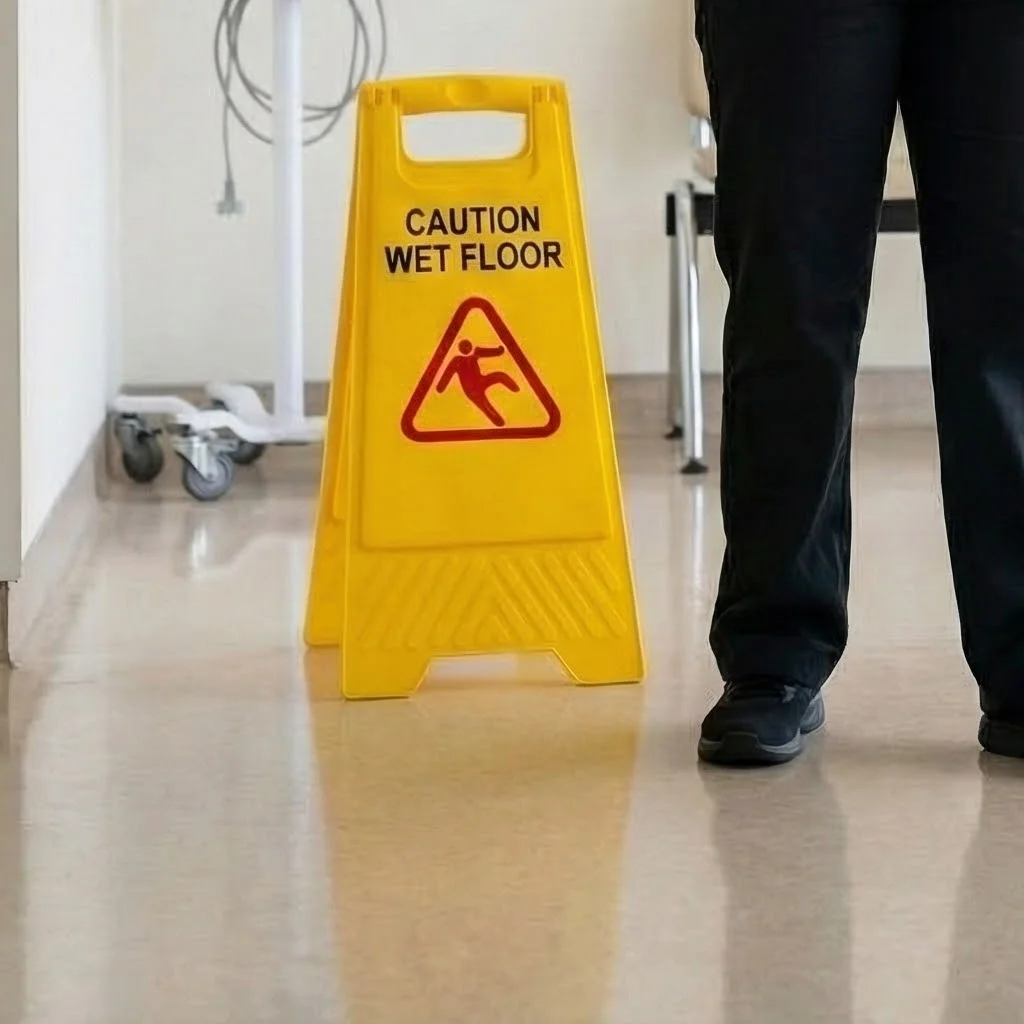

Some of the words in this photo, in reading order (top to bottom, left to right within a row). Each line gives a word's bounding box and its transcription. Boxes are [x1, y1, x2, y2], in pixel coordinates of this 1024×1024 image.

[406, 206, 540, 236] CAUTION
[385, 244, 451, 274] WET
[461, 241, 564, 271] FLOOR
